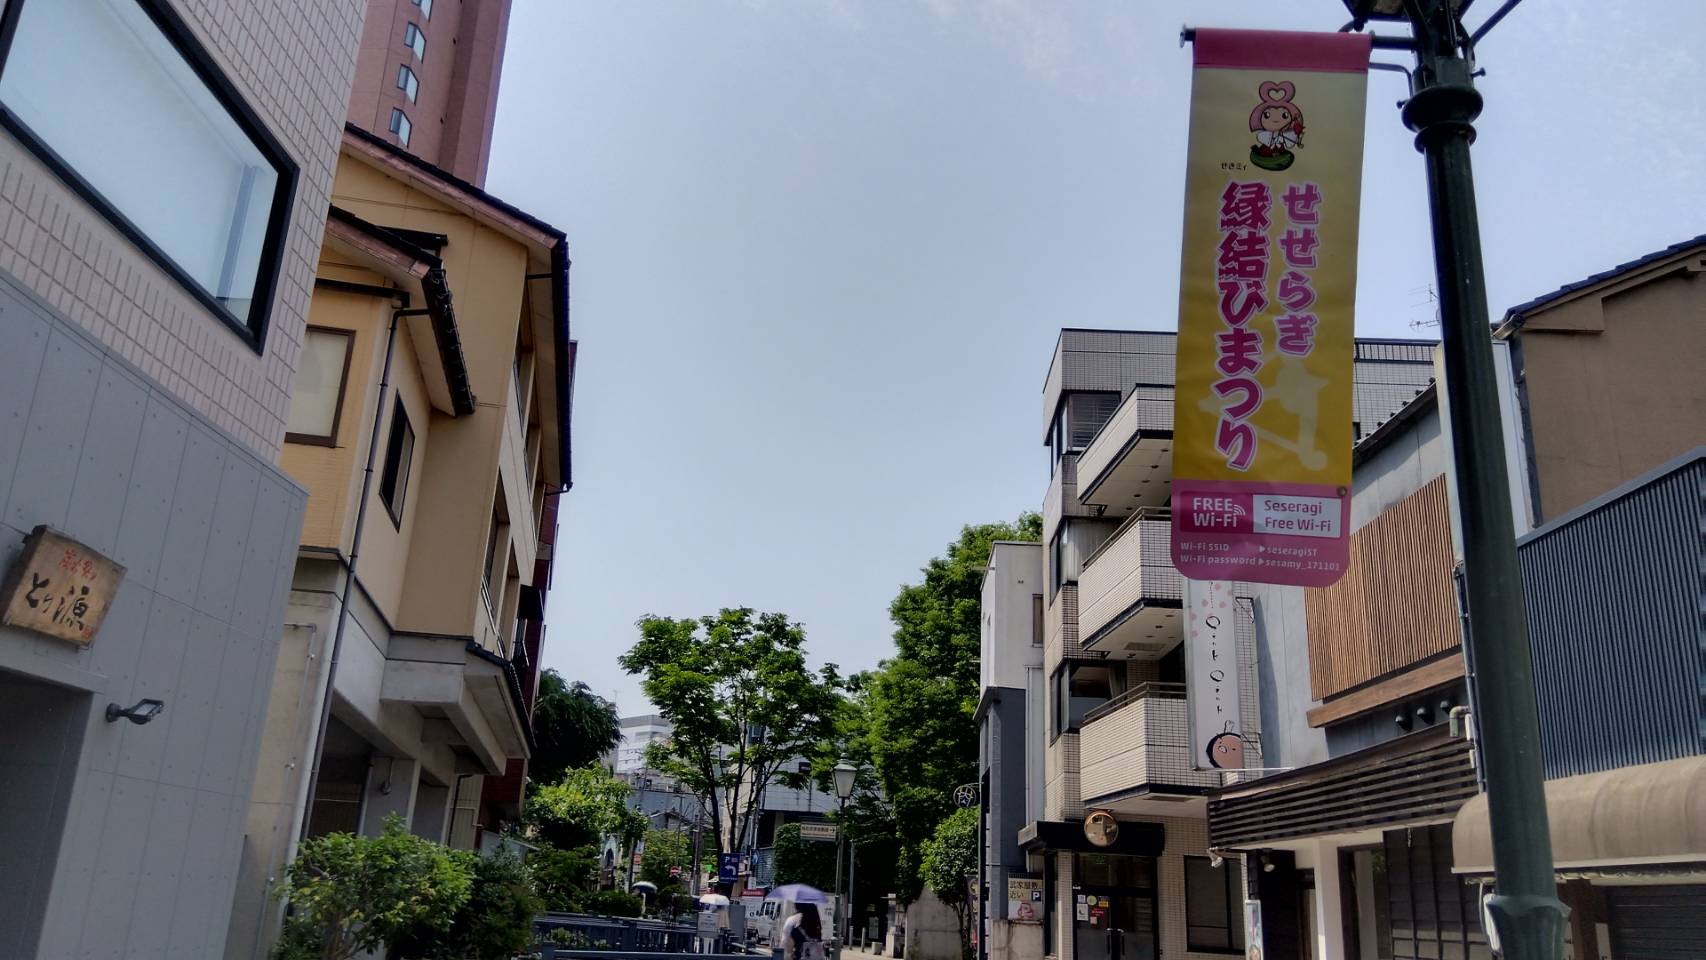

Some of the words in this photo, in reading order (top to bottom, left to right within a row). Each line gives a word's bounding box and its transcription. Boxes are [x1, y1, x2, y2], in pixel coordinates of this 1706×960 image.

[1276, 183, 1321, 356] せせらぎ
[1214, 181, 1271, 471] 縁結びまつり
[1193, 497, 1233, 511] FREE
[1264, 499, 1323, 515] Seseragi
[1193, 511, 1237, 528] Wi-Fi
[1265, 516, 1294, 531] Free
[1297, 517, 1331, 532] Wi-Fi
[1180, 542, 1206, 551] Wi-Fi
[1208, 543, 1230, 551] SSID
[1180, 554, 1206, 563] Wi-Fi
[1208, 555, 1256, 565] password
